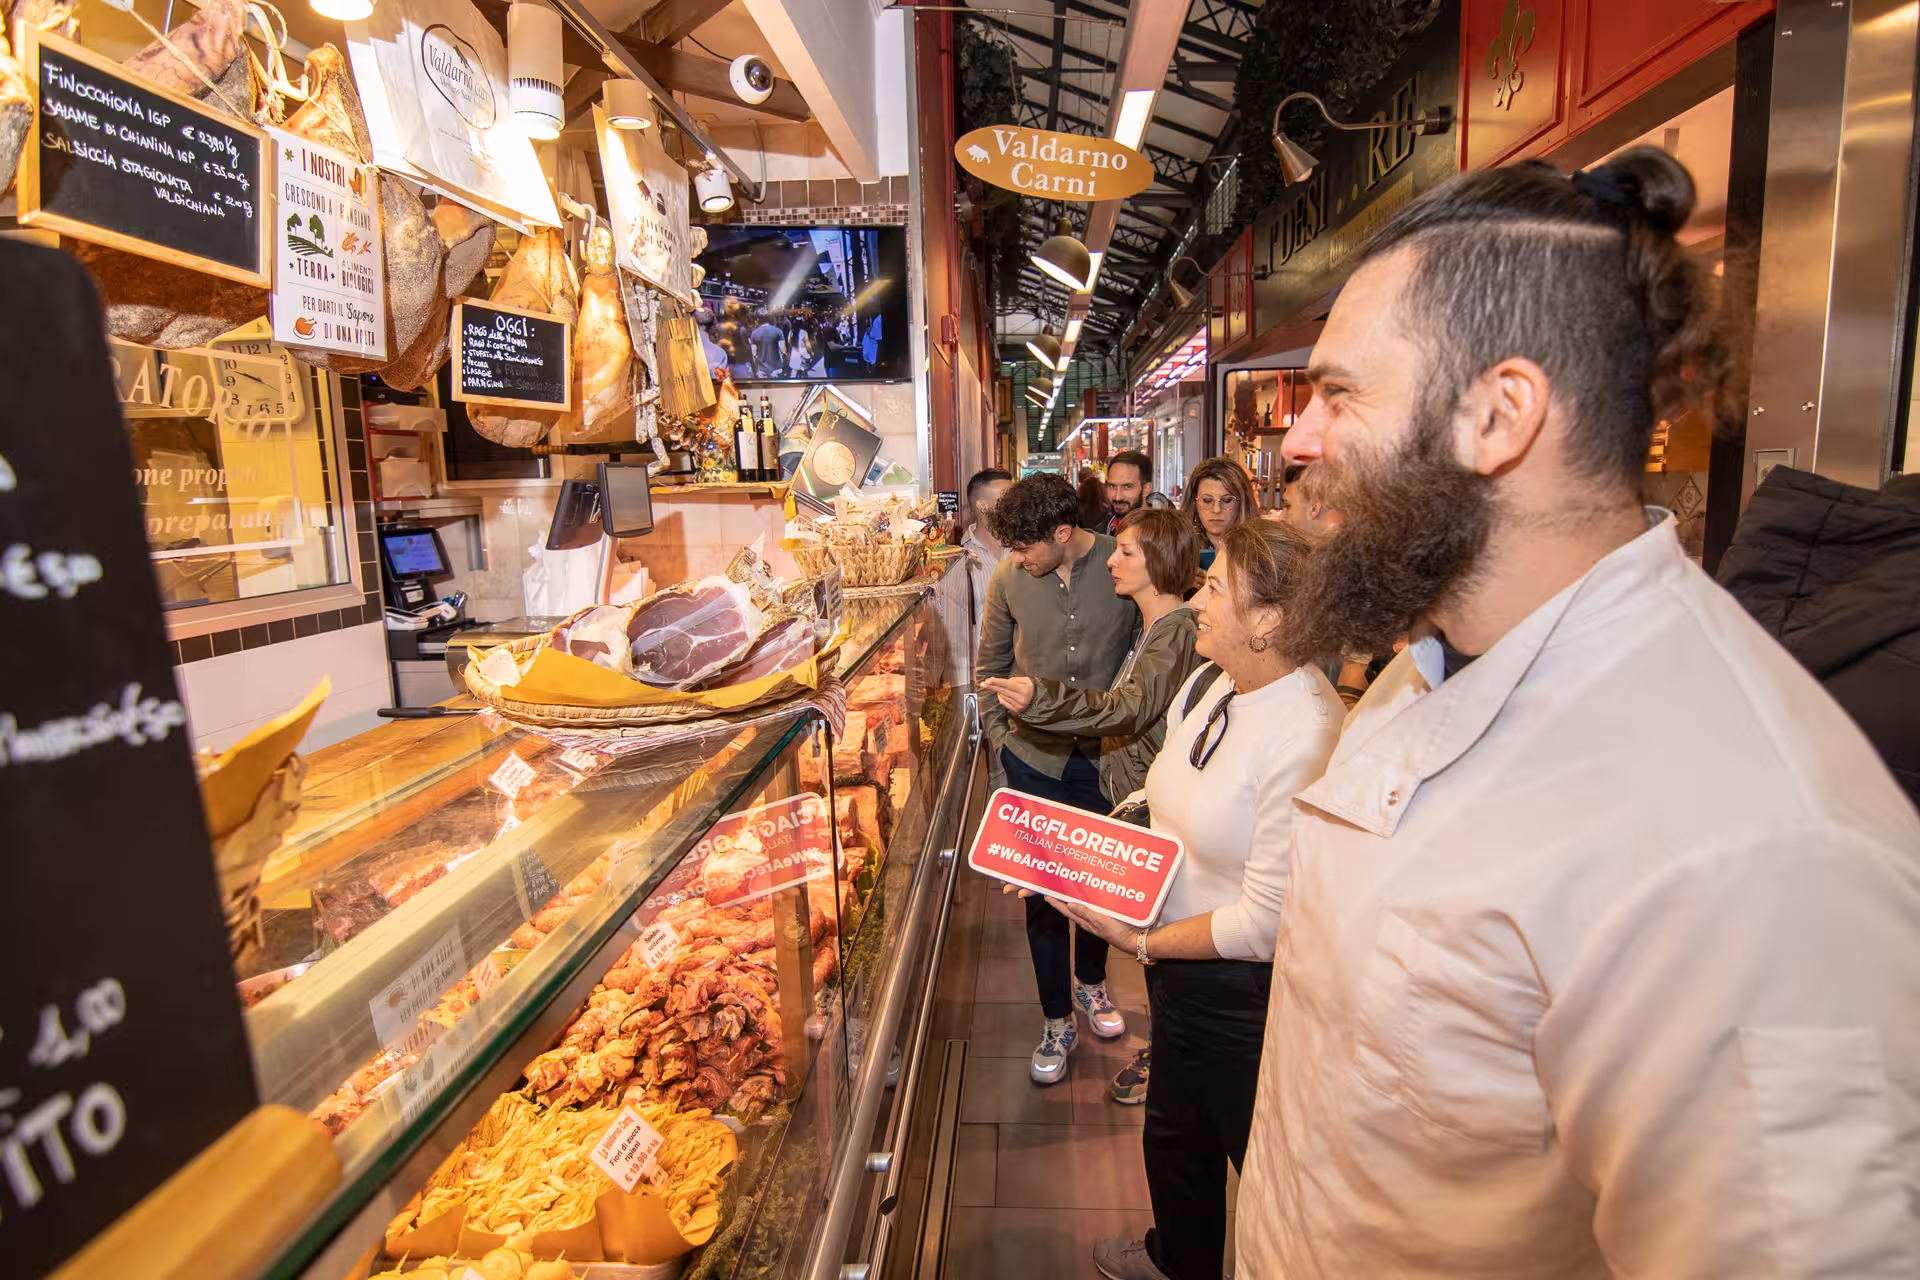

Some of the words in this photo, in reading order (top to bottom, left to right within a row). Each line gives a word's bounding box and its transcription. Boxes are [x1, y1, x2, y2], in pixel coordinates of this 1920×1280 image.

[429, 44, 473, 89] Valdarno
[41, 98, 101, 130] SALAME
[177, 149, 196, 164] IGP
[203, 161, 212, 174] €
[148, 109, 171, 128] IGP
[181, 126, 195, 140] €
[992, 129, 1128, 170] Valdarno
[301, 148, 307, 172] I
[310, 150, 346, 188] NOSTRI
[1011, 162, 1096, 196] Carni
[213, 191, 222, 201] €
[284, 182, 326, 214] CRESCONO
[328, 198, 333, 216] A
[296, 257, 329, 282] TERRA
[341, 260, 374, 278] ALIMENTI
[342, 270, 374, 295] BIOLOGICI
[302, 295, 316, 312] PER
[318, 298, 337, 316] DARTI
[338, 303, 344, 317] IL
[346, 302, 375, 327] Sapore
[324, 322, 332, 340] DI
[336, 324, 352, 343] UNA
[224, 360, 237, 370] 10
[246, 344, 261, 355] 12
[226, 376, 236, 387] 9
[276, 403, 284, 414] 5
[1014, 829, 1052, 850] ITALIAN
[1054, 843, 1127, 876] EXPERIENCES
[987, 842, 1146, 902] #WeAreCiaoFlorence
[609, 1150, 623, 1166] Fiori
[621, 1141, 628, 1151] di
[626, 1125, 641, 1144] zucca
[624, 1140, 641, 1162] ripieni
[624, 1173, 633, 1182] €
[629, 1151, 648, 1174] 19,90
[650, 1138, 659, 1149] kg
